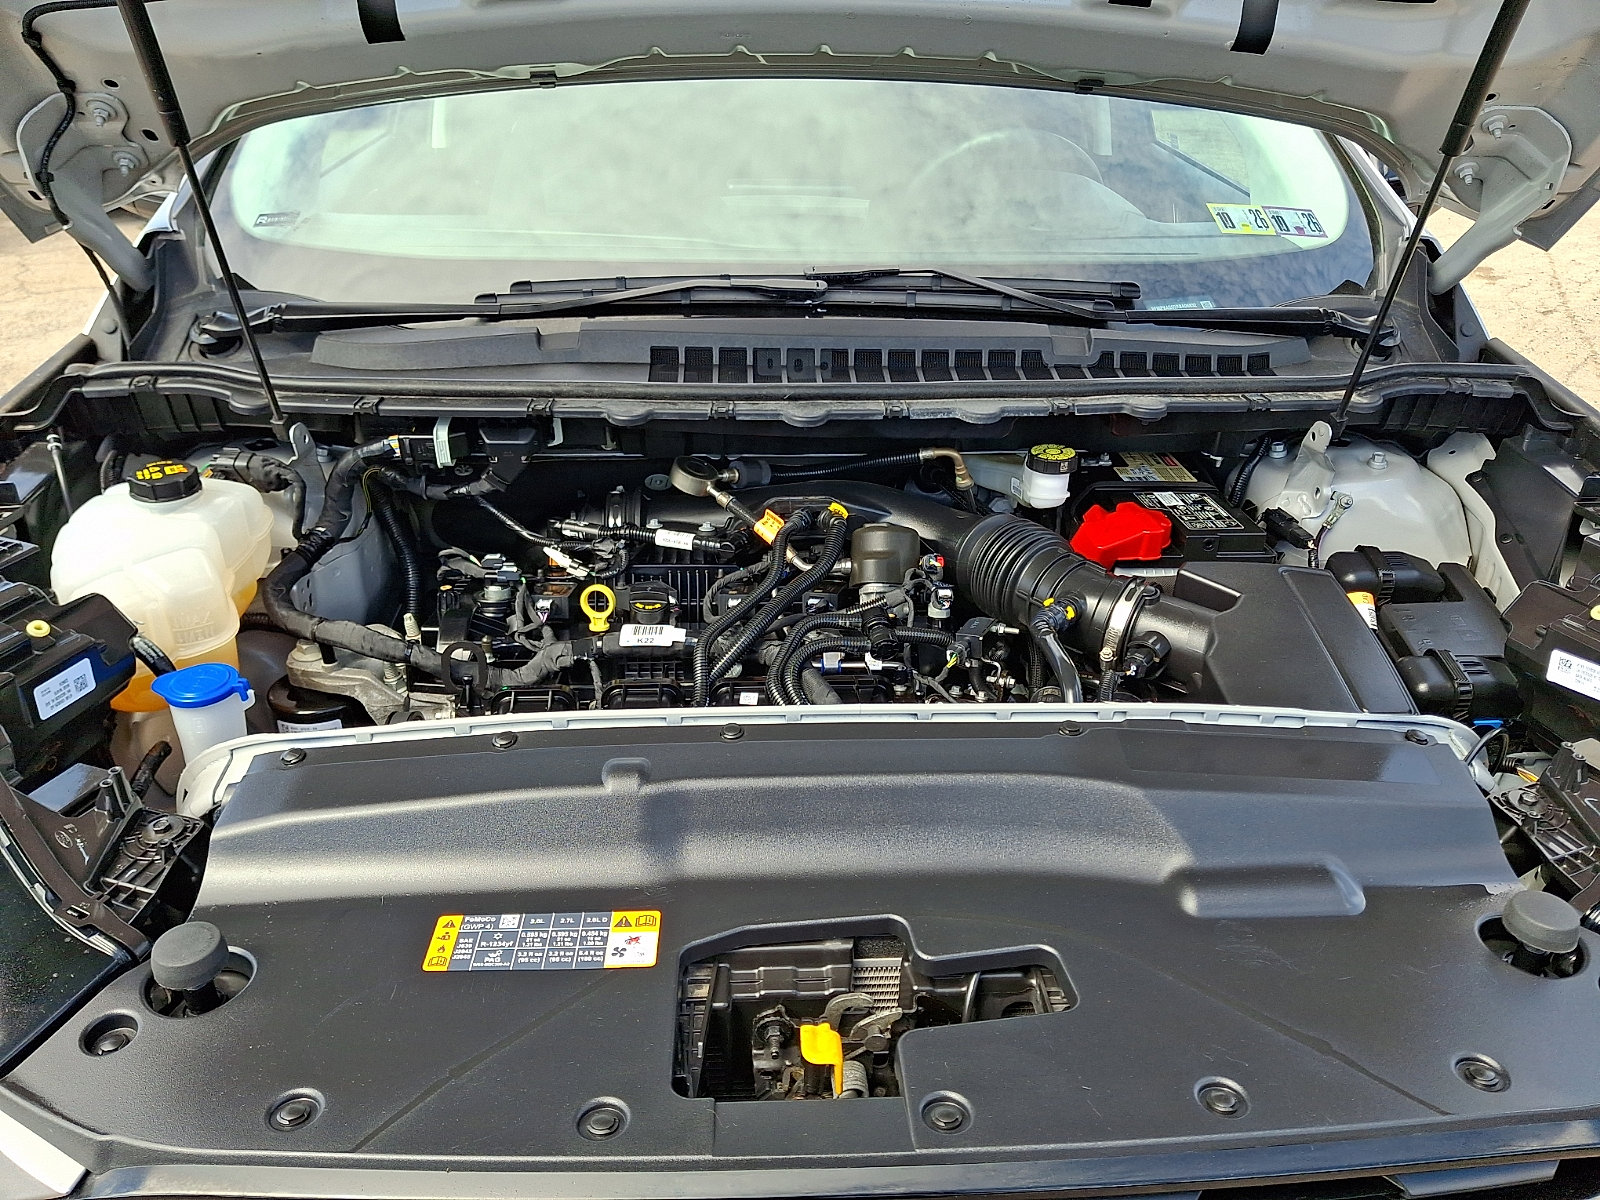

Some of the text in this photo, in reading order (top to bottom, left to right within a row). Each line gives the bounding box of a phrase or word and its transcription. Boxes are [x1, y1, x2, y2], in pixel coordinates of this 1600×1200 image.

[1216, 208, 1270, 229] 10 26
[1271, 212, 1323, 233] 10 26
[460, 923, 494, 931] (GWP 4)
[480, 940, 514, 948] R-1234yf
